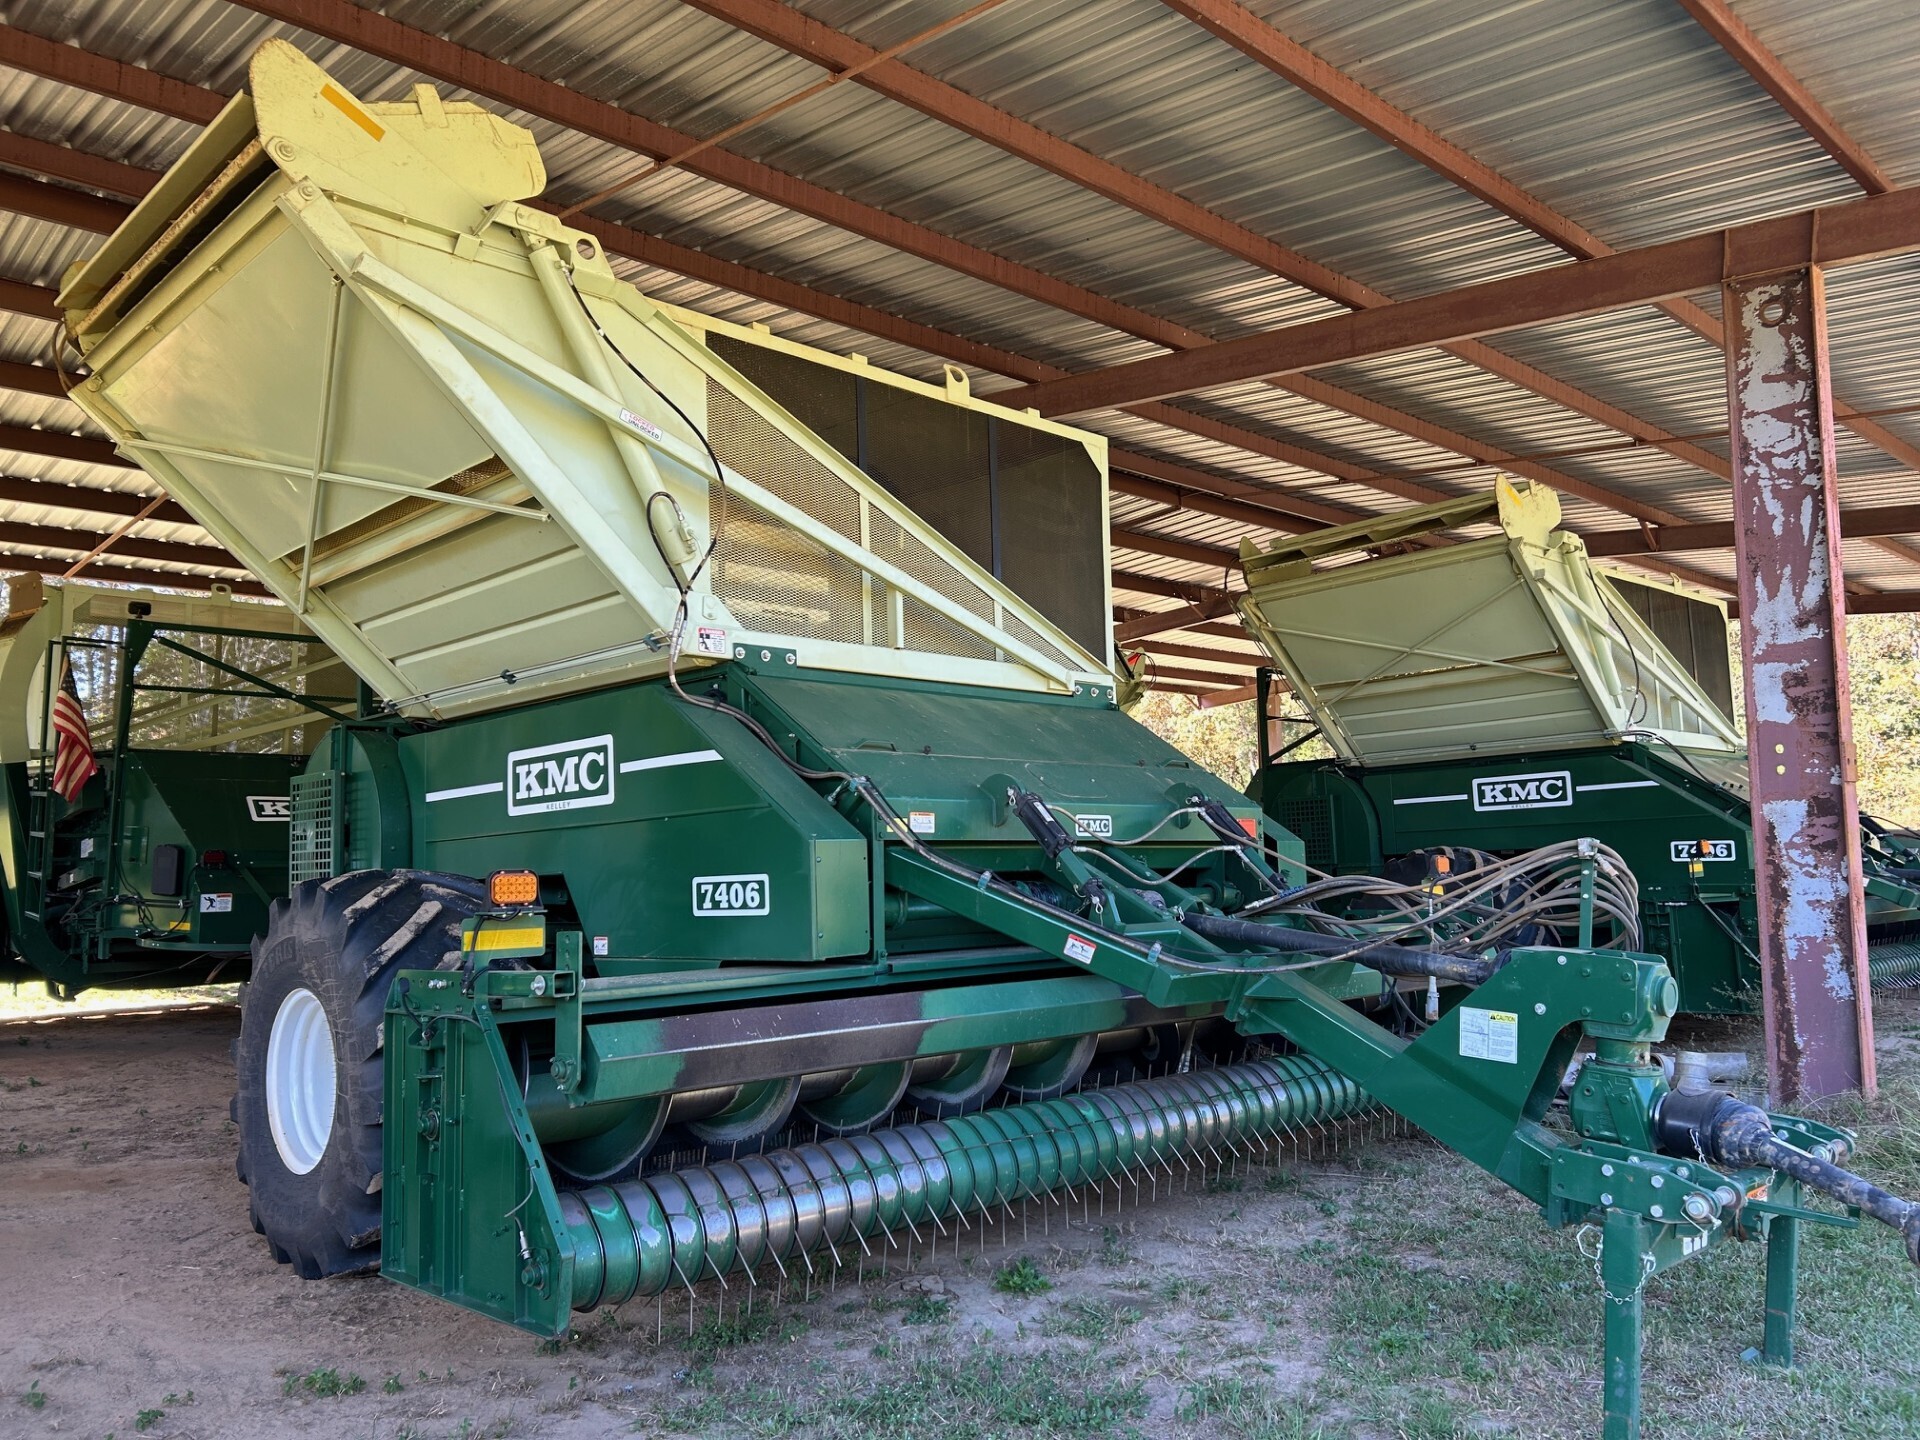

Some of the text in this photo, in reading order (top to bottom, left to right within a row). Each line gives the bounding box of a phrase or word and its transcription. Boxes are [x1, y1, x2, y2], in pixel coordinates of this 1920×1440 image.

[628, 418, 660, 440] UNLOCKED
[515, 751, 605, 800] KMC
[1481, 779, 1563, 804] KMC
[546, 801, 571, 810] KELLEY
[1078, 819, 1109, 832] KMC
[700, 882, 760, 909] 7406
[1496, 1014, 1516, 1022] CAUTION
